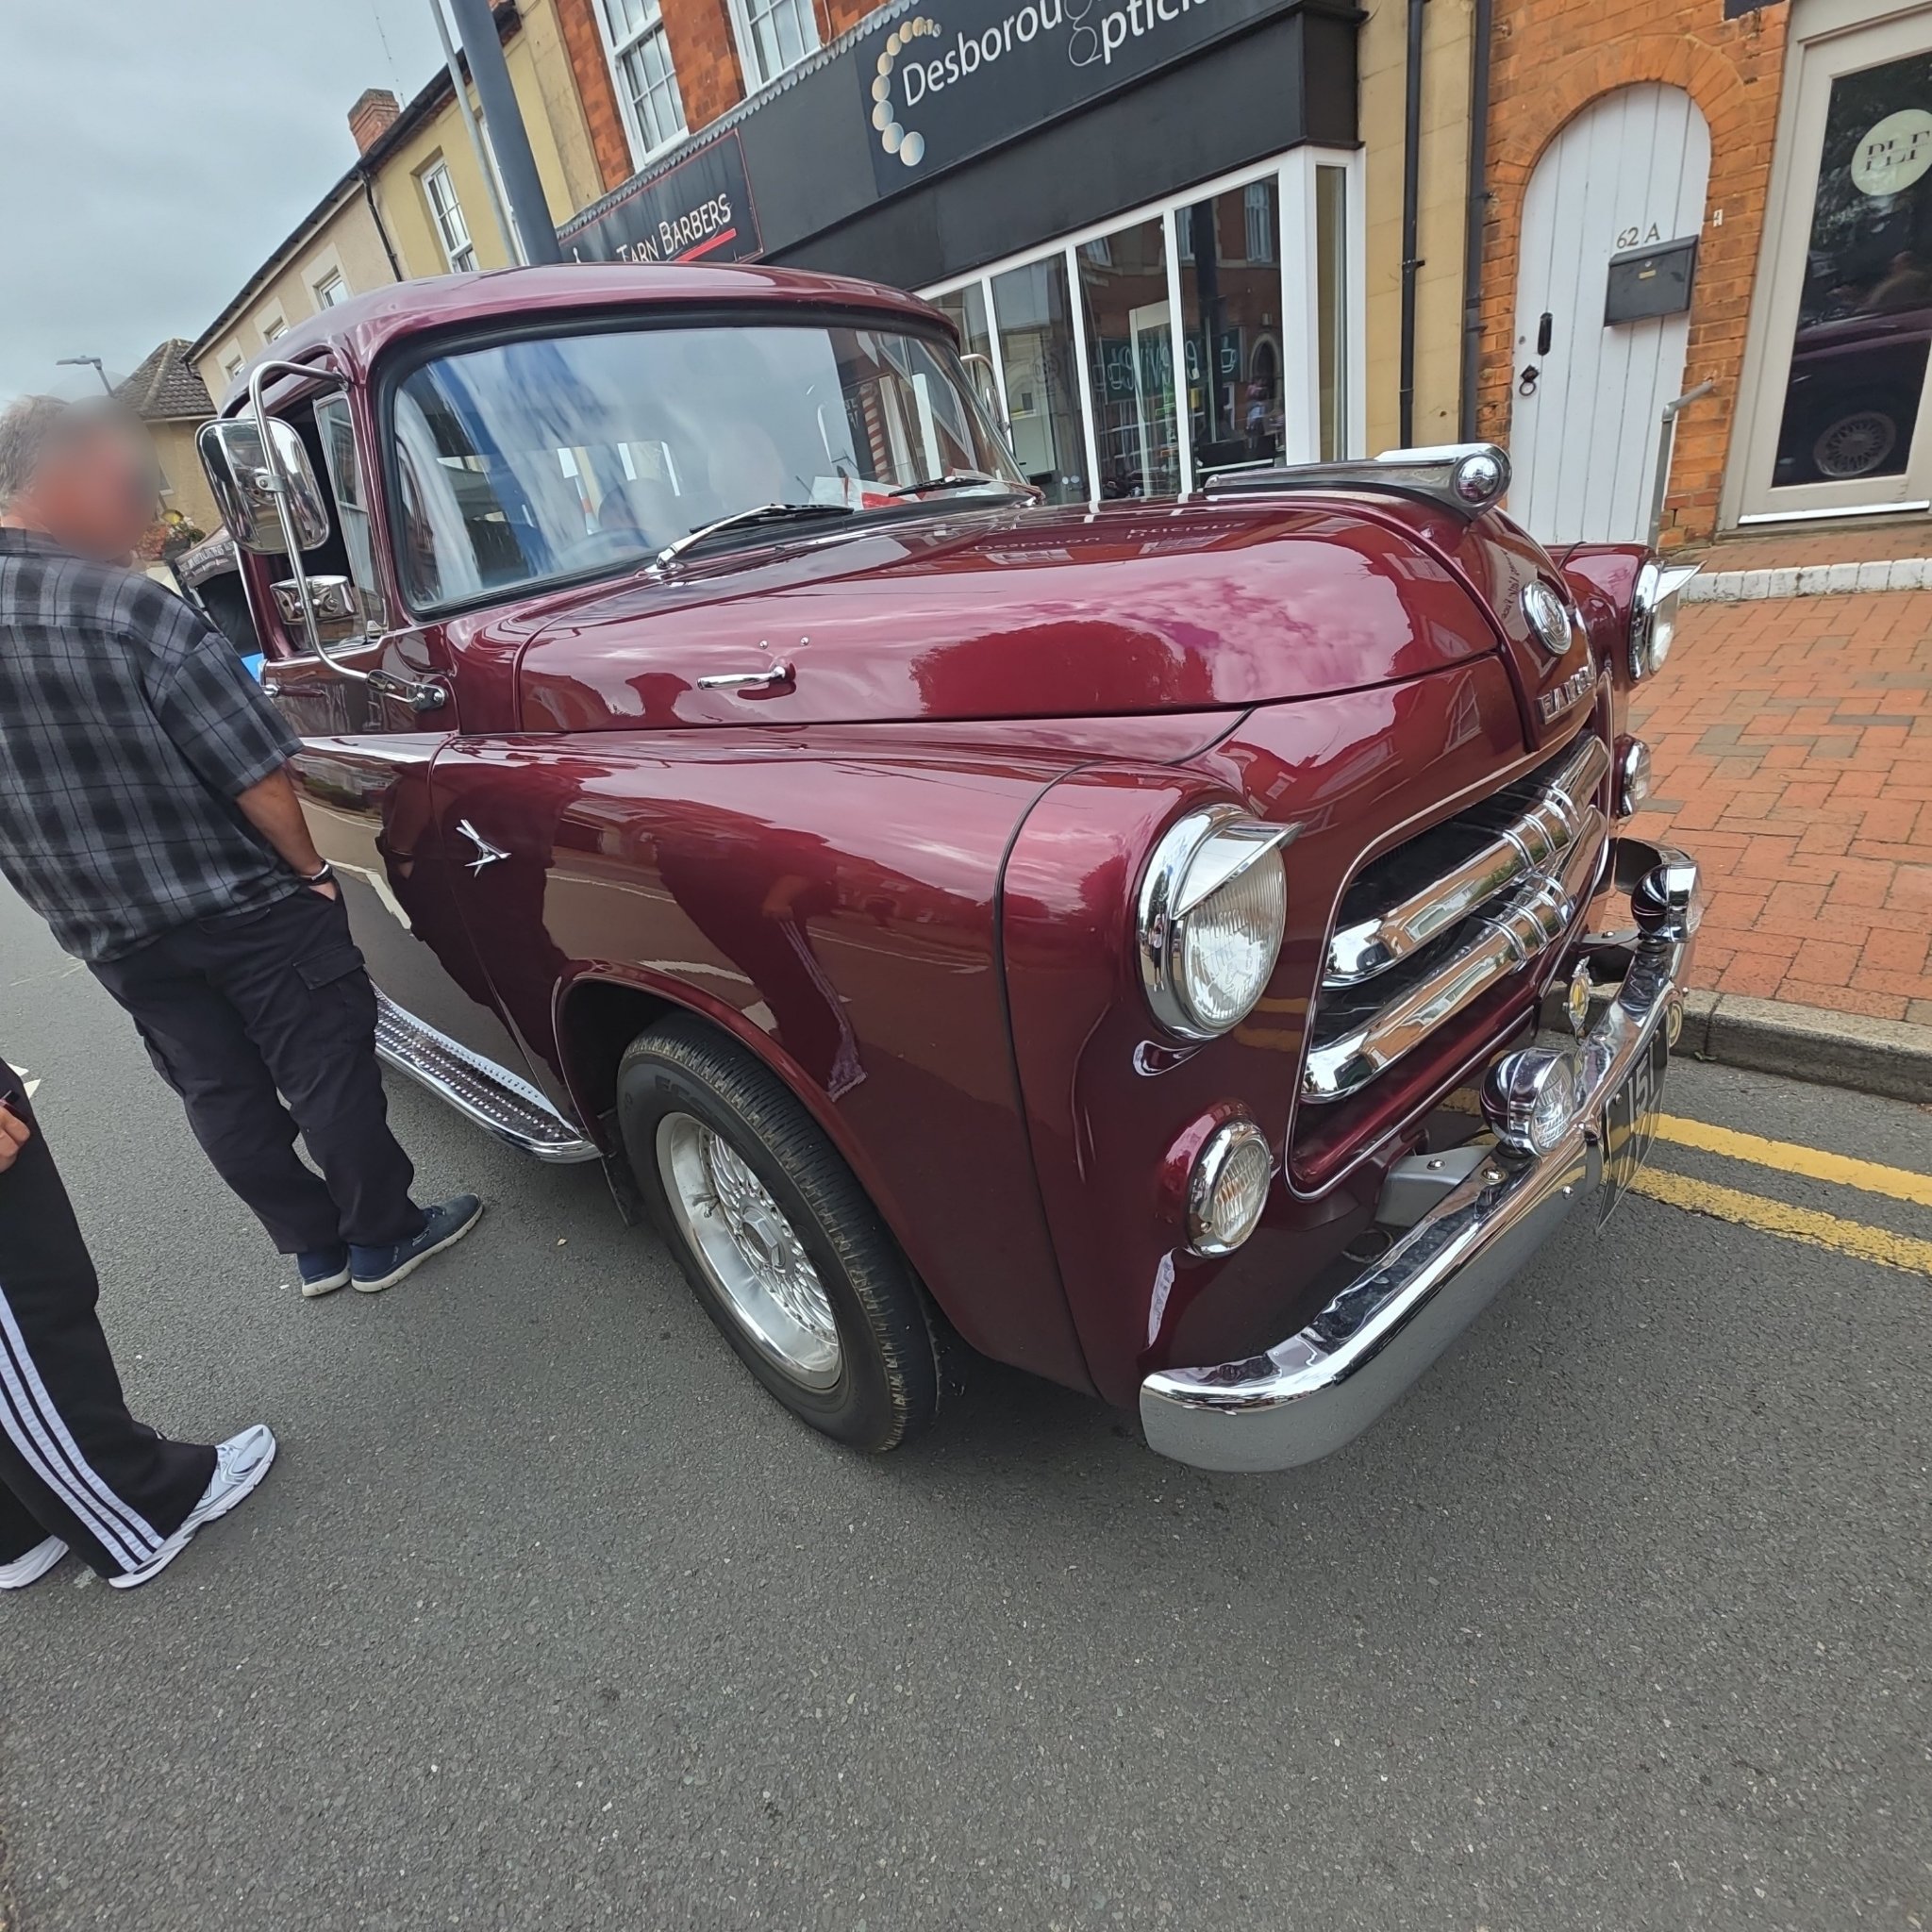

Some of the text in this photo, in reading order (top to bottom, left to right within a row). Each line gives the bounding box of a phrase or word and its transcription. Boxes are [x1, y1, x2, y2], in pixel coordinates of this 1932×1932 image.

[658, 192, 732, 256] BARBERS
[1616, 222, 1660, 249] 62 A
